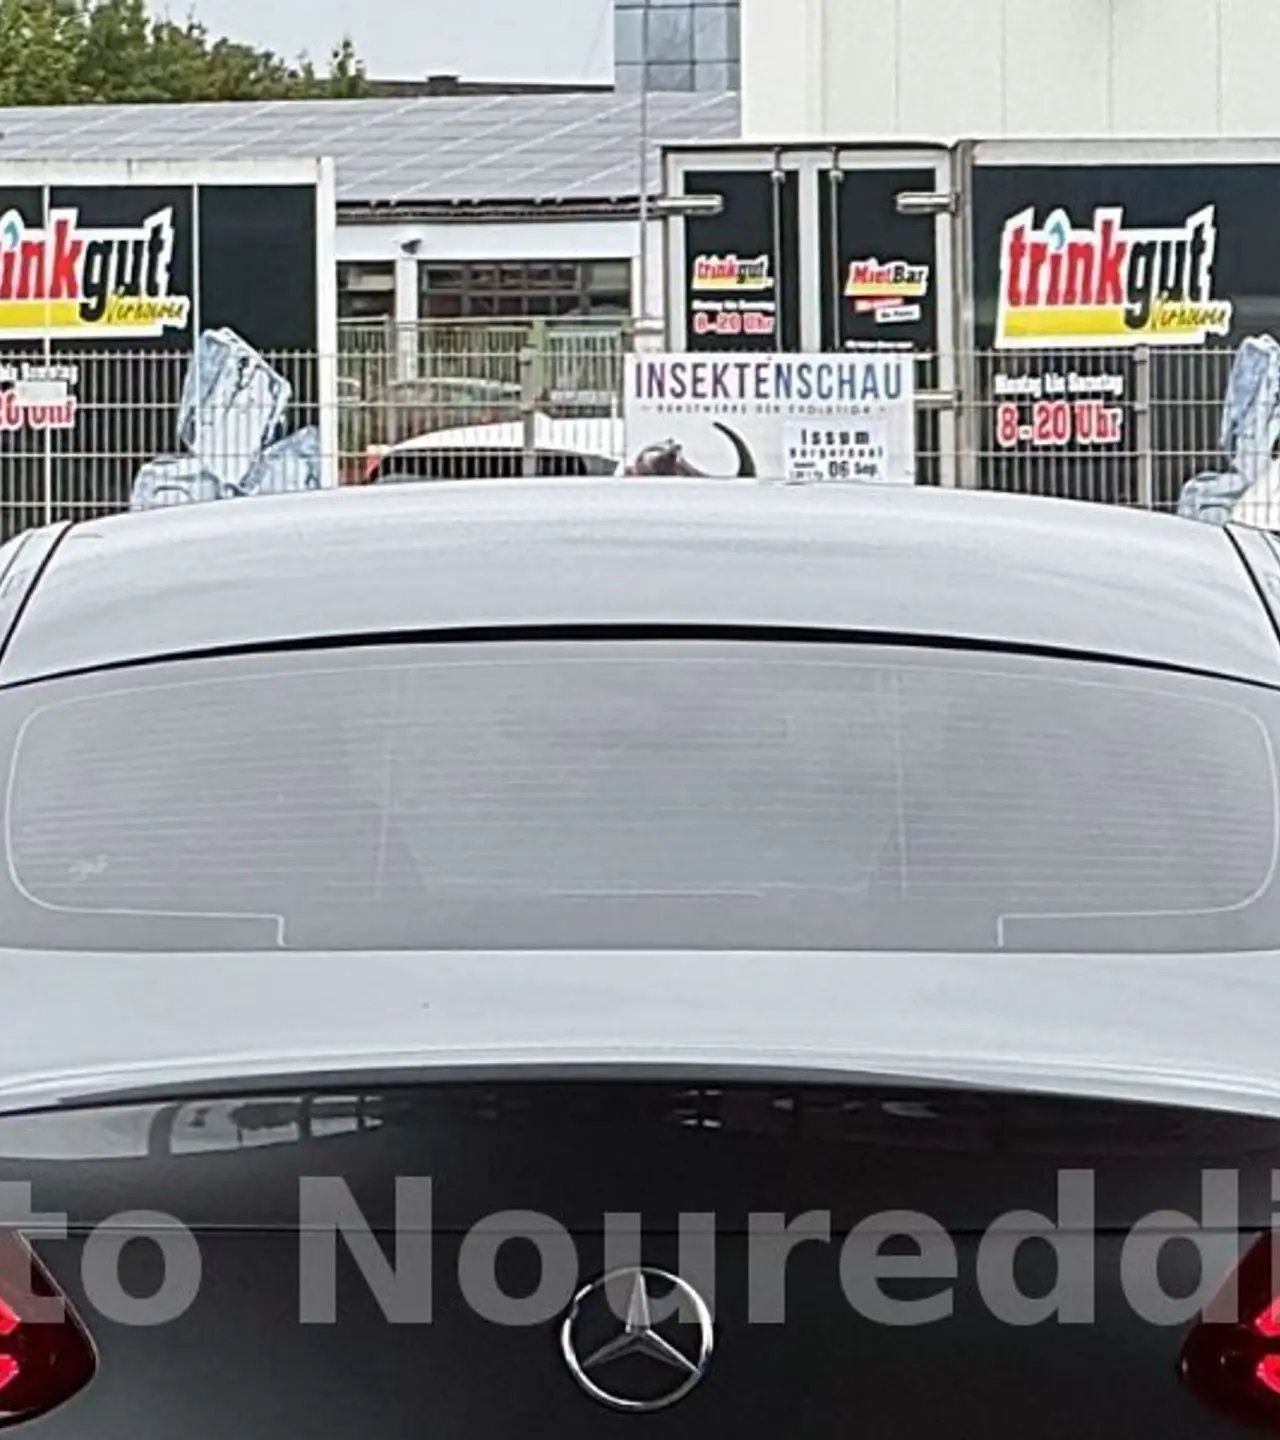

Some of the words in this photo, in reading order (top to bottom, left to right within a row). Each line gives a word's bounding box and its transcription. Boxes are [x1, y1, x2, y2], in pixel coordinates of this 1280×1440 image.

[1007, 217, 1207, 330] trinkgut
[635, 361, 902, 400] INSEKTENSCHAU
[1075, 401, 1122, 443] Uhr
